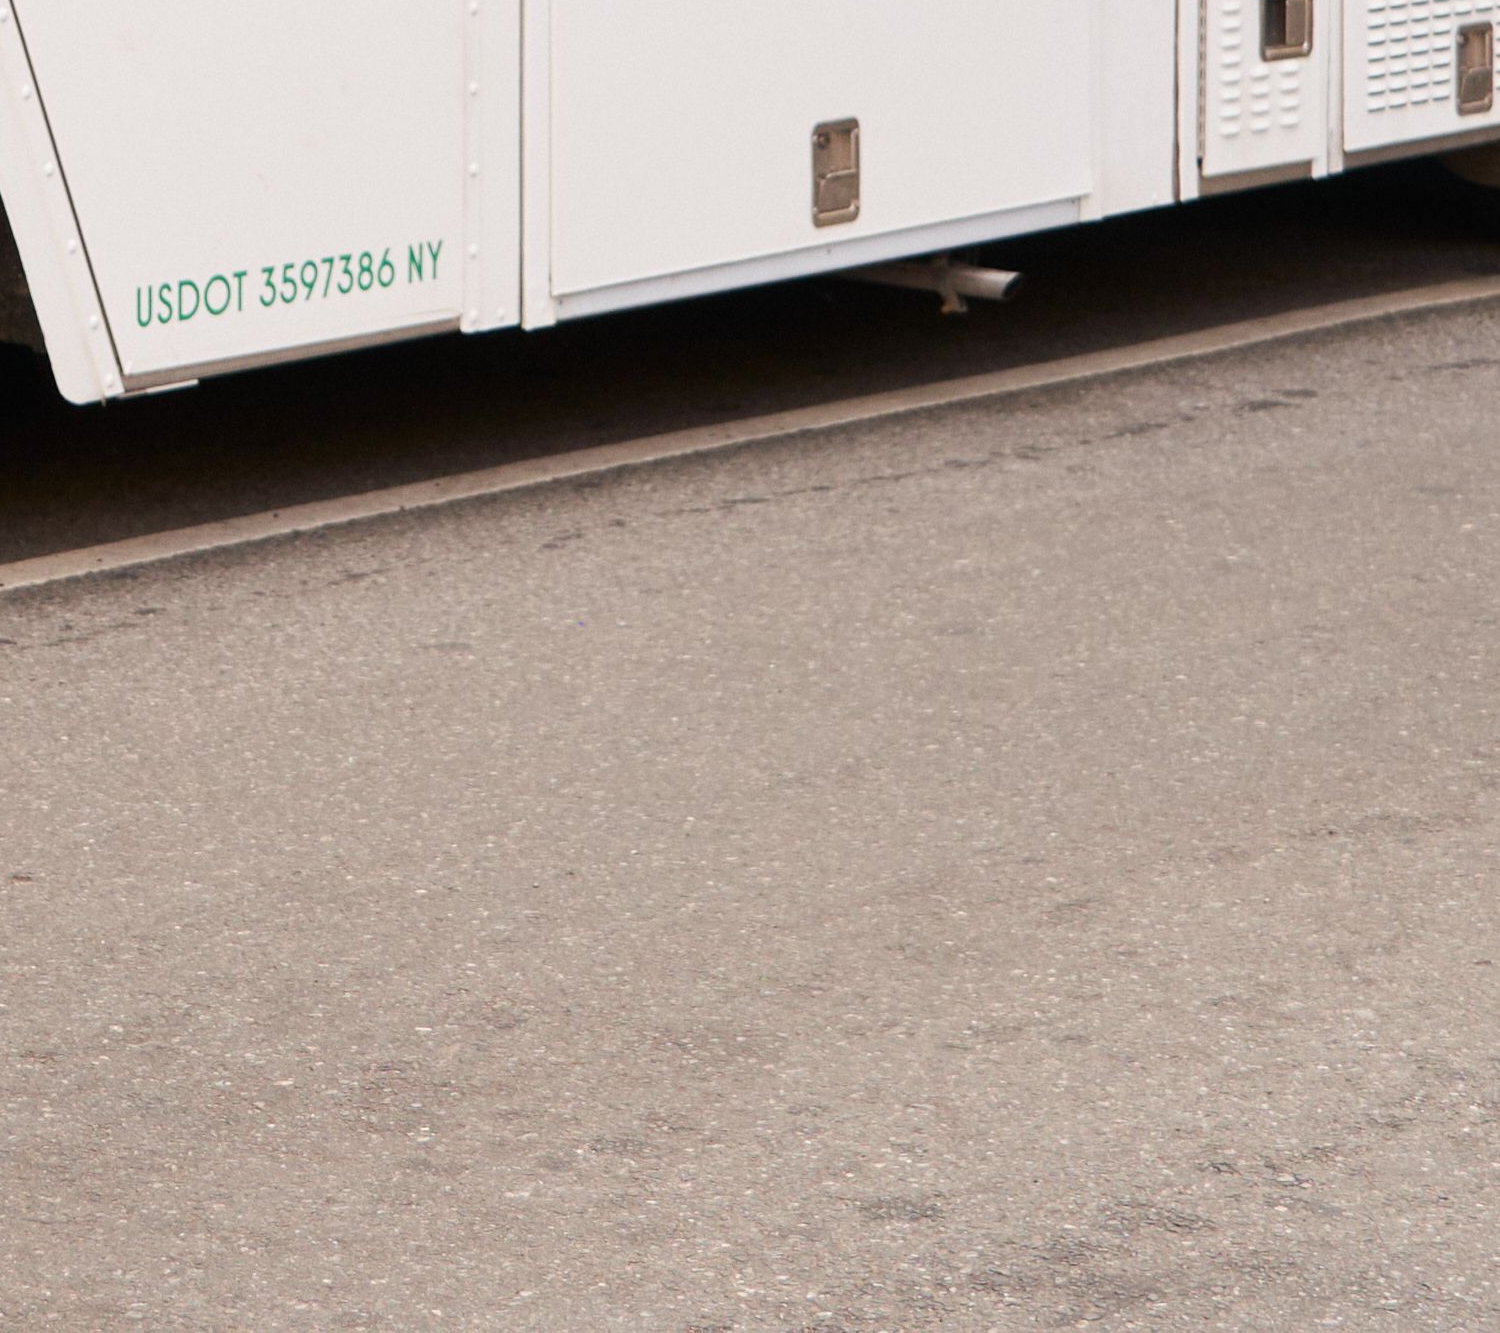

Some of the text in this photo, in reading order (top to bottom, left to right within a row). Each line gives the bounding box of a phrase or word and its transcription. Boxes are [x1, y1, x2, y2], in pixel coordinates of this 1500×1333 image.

[135, 238, 445, 329] USDOT 3597386 NY
